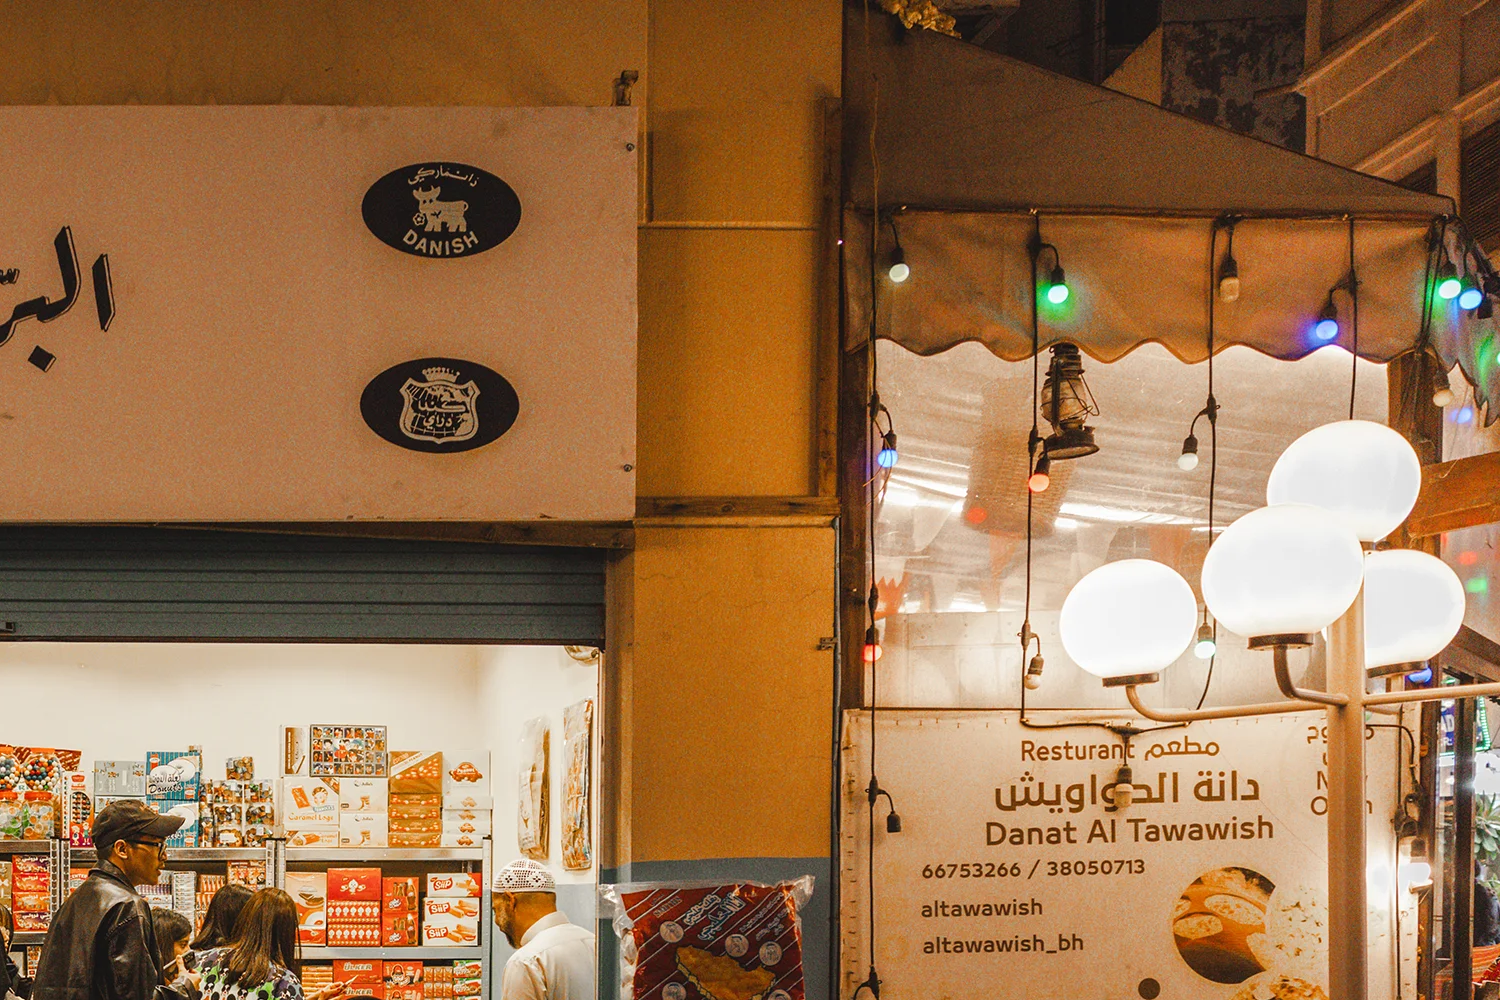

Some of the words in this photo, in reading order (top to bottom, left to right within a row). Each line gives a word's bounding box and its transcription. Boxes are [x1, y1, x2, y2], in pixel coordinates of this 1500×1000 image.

[402, 228, 480, 256] DANISH
[1021, 740, 1135, 761] Resturant
[1145, 735, 1220, 761] مطعم
[1193, 770, 1260, 801] دانة
[986, 820, 1077, 847] Danat
[1087, 820, 1117, 844] Al
[1126, 815, 1275, 844] Tawawish
[921, 862, 1022, 880] 66753266
[1027, 859, 1040, 881] /
[1046, 859, 1146, 877] 38050713
[921, 899, 1043, 919] altawawish
[922, 934, 1085, 955] altawawish_bh
